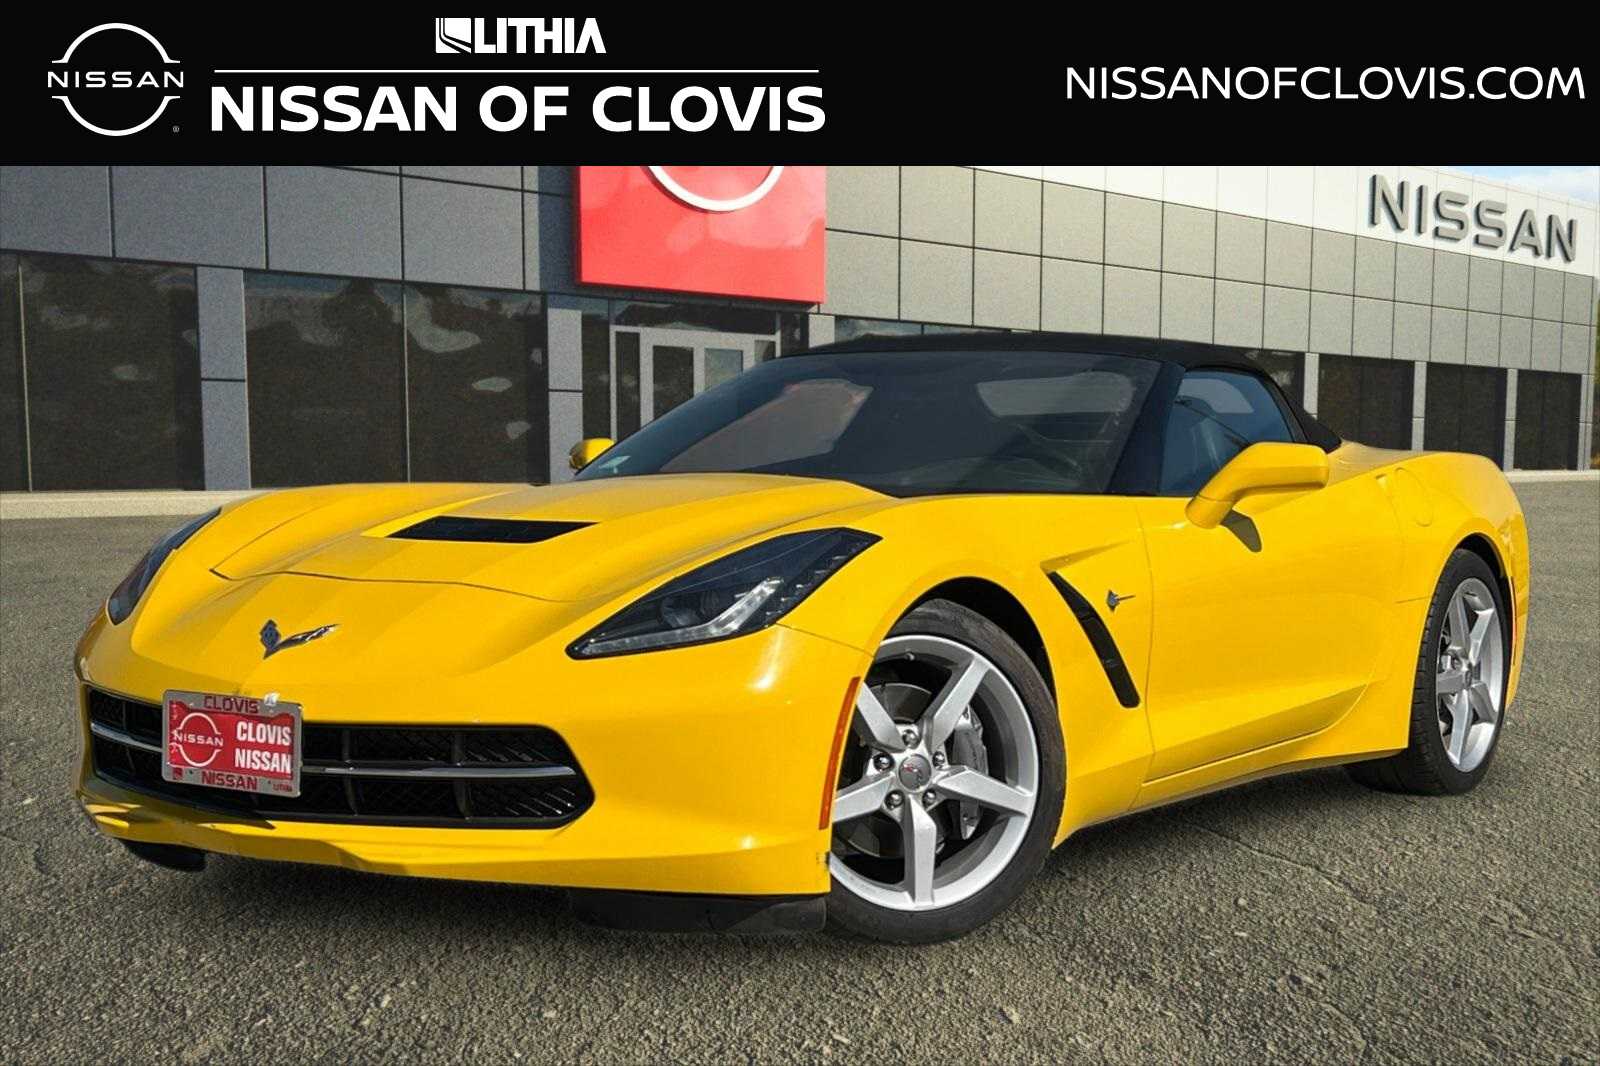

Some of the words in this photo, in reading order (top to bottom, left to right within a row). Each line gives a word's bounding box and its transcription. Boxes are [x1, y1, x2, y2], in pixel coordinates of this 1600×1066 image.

[1369, 174, 1577, 262] NISSAN
[204, 695, 259, 713] CLOVIS
[173, 731, 223, 747] NISSAN
[236, 721, 291, 746] CLOVIS
[235, 748, 291, 774] NISSAN
[201, 771, 257, 790] NISSAN
